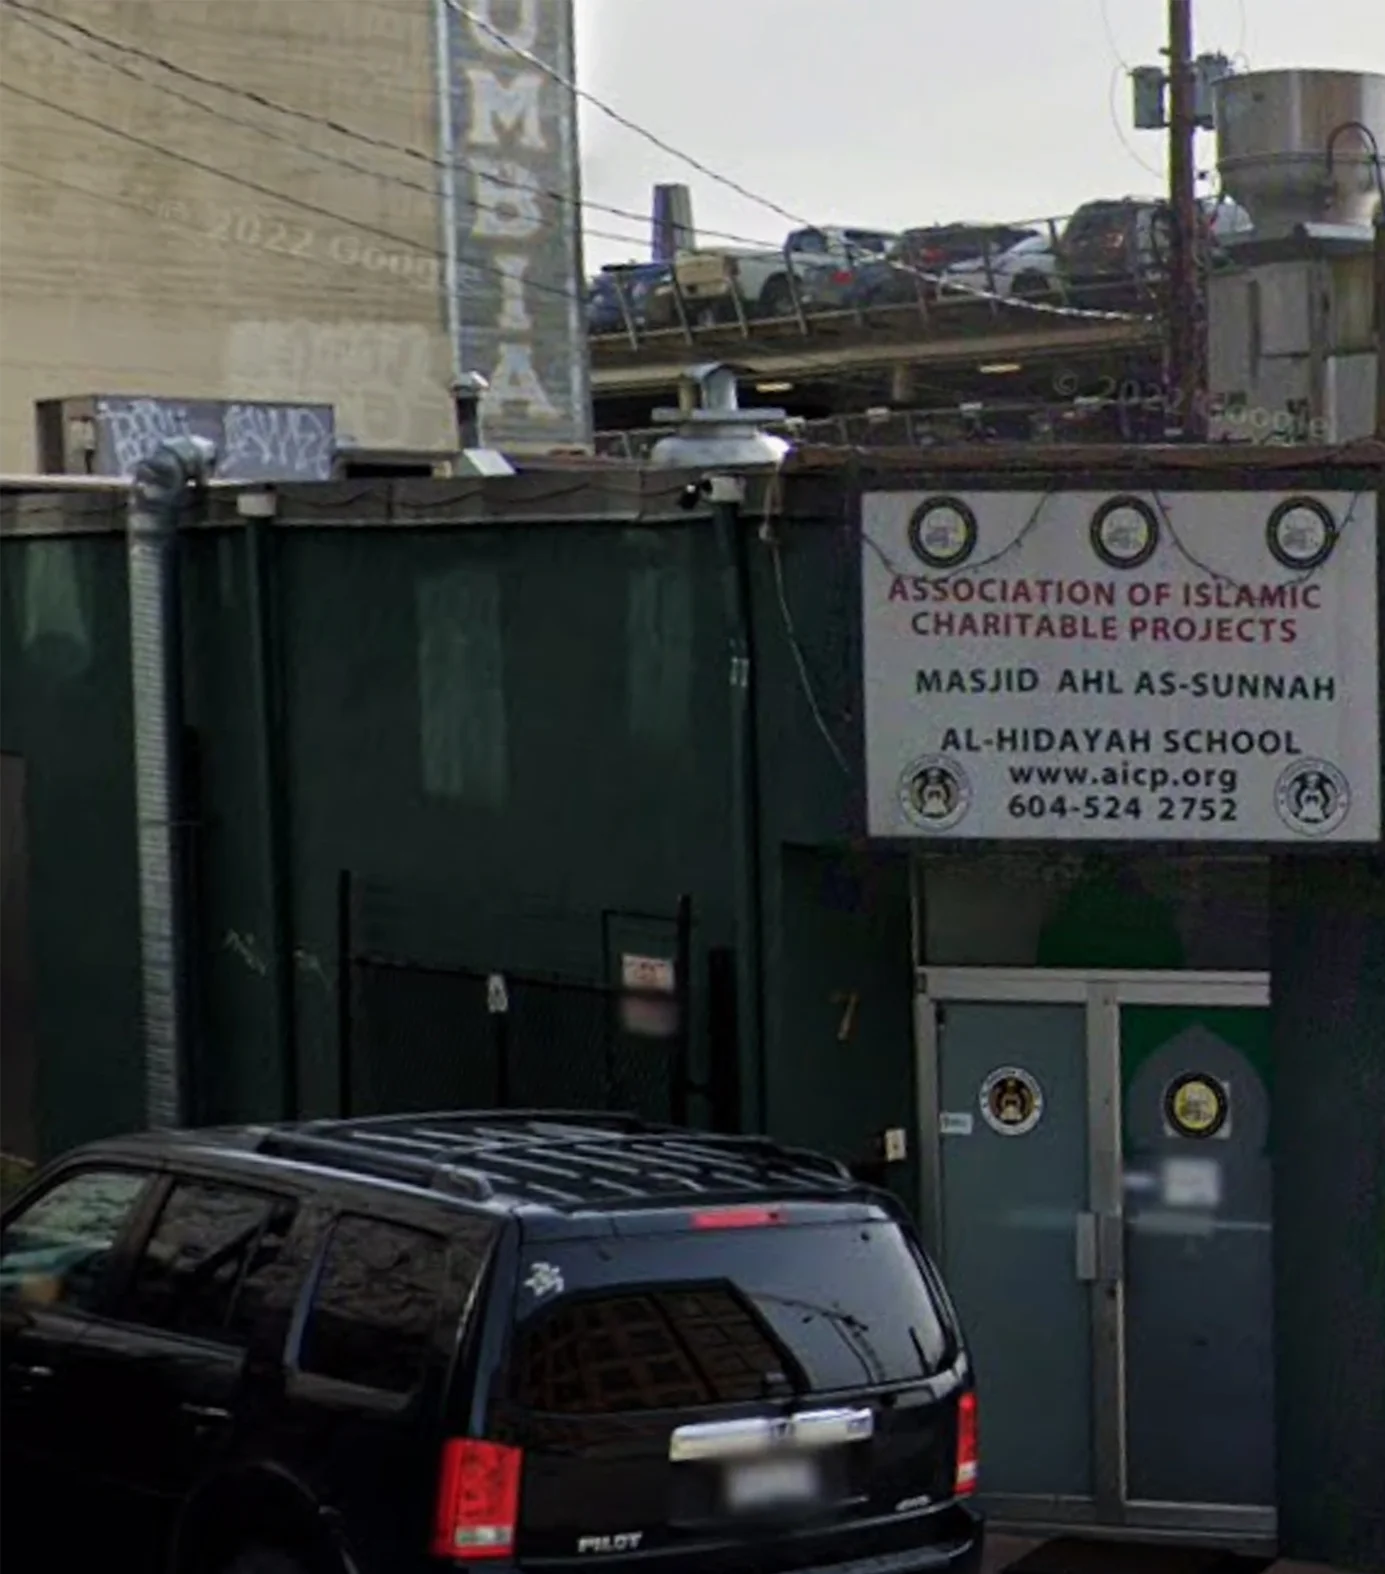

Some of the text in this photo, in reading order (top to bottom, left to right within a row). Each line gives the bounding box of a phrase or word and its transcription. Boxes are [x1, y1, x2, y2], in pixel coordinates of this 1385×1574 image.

[888, 577, 1321, 609] ASSOCIATION OF ISLAMIC
[911, 612, 1297, 643] CHARITABLE PROJECTS
[916, 668, 1335, 701] MASJID AHL AS-SUNNAH
[941, 728, 1302, 754] AL-HIDAYAH SCHOOL
[1008, 761, 1237, 794] www.aicp.org
[1008, 794, 1237, 821] 604-524 2752
